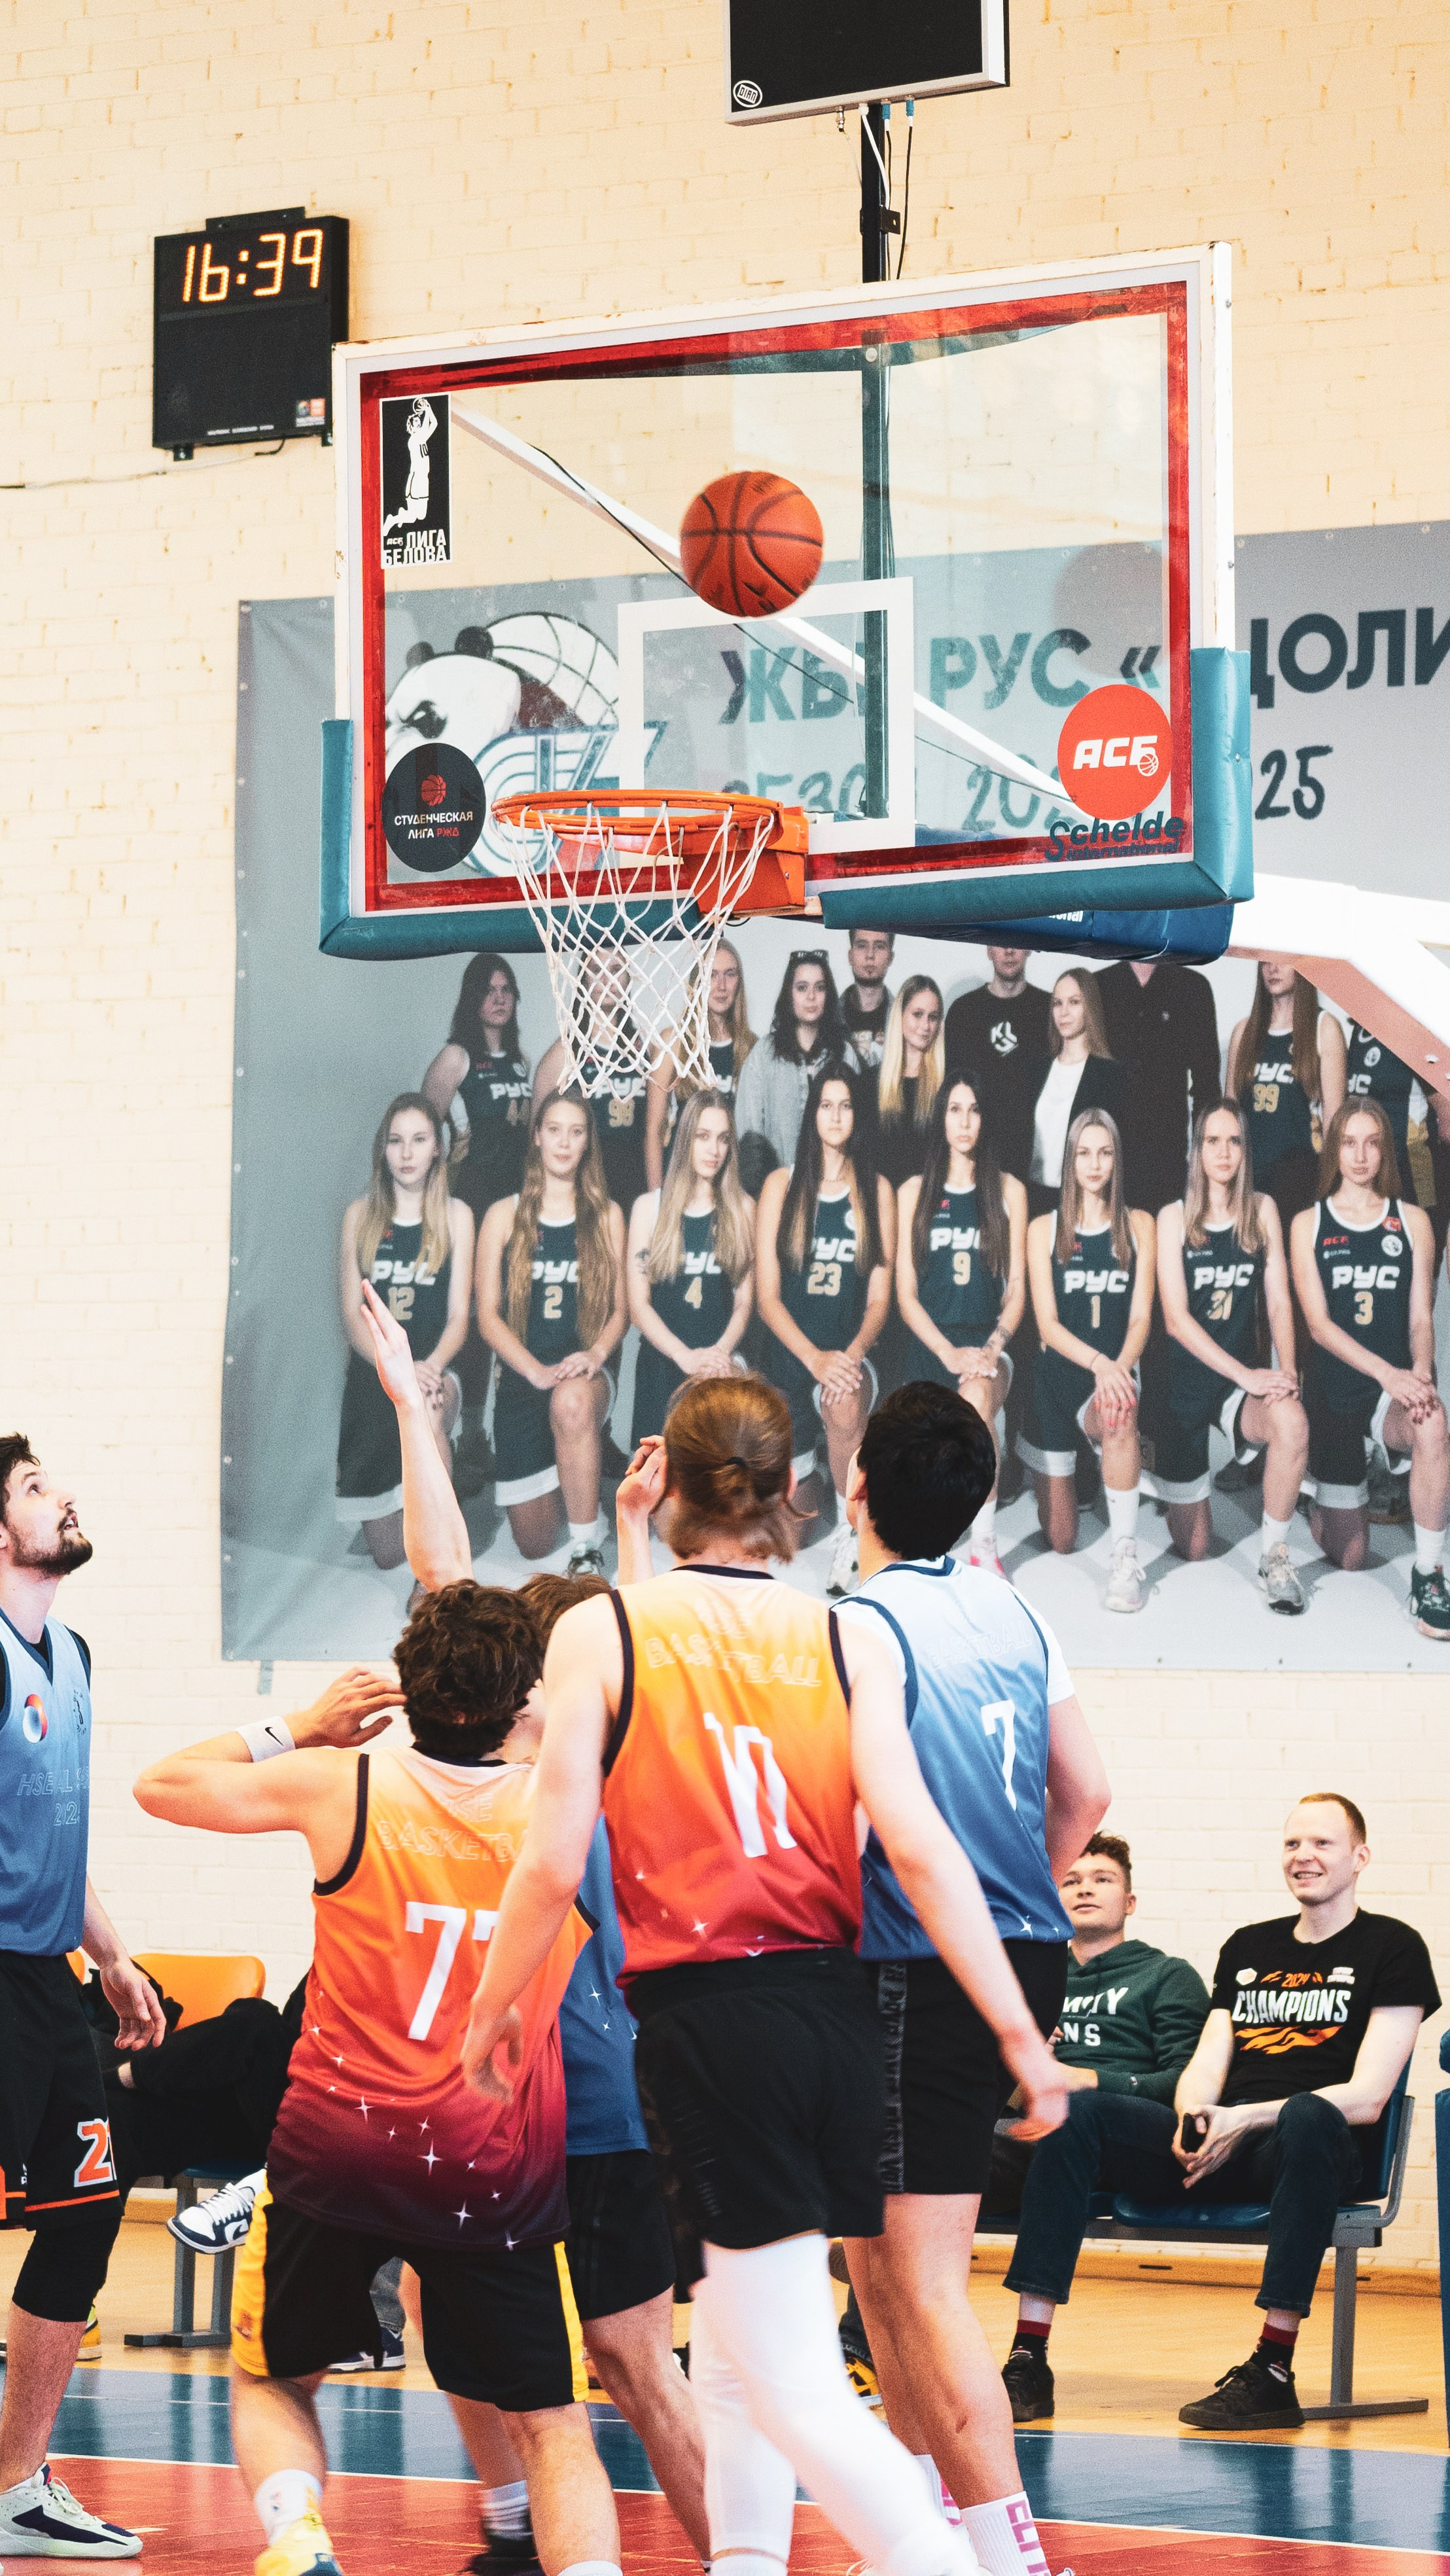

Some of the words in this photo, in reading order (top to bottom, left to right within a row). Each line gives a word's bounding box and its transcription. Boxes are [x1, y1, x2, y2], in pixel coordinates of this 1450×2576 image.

[182, 228, 323, 302] 16:39
[406, 528, 447, 548] ЛИГА
[383, 545, 448, 566] БЕЛОВА
[719, 640, 866, 724] ЖБ
[928, 627, 1092, 709] РУС
[394, 811, 473, 826] СТУДЕНЧЕСКАЯ
[408, 827, 434, 840] ЛИГА
[436, 827, 460, 838] РЖД
[1044, 810, 1184, 862] Schelde
[813, 1237, 857, 1262] УС
[807, 1262, 842, 1297] 23
[953, 1251, 972, 1285] 9
[1063, 1270, 1130, 1294] РУС
[1194, 1263, 1255, 1291] РУС
[1332, 1264, 1401, 1290] РУС
[544, 1285, 563, 1319] 2
[684, 1276, 703, 1309] 4
[1354, 1290, 1374, 1326] 3
[1090, 1295, 1101, 1329] 1
[980, 1698, 1017, 1812] 7
[1281, 1972, 1311, 1988] 2024
[1231, 1988, 1352, 2024] CHAMPIONS
